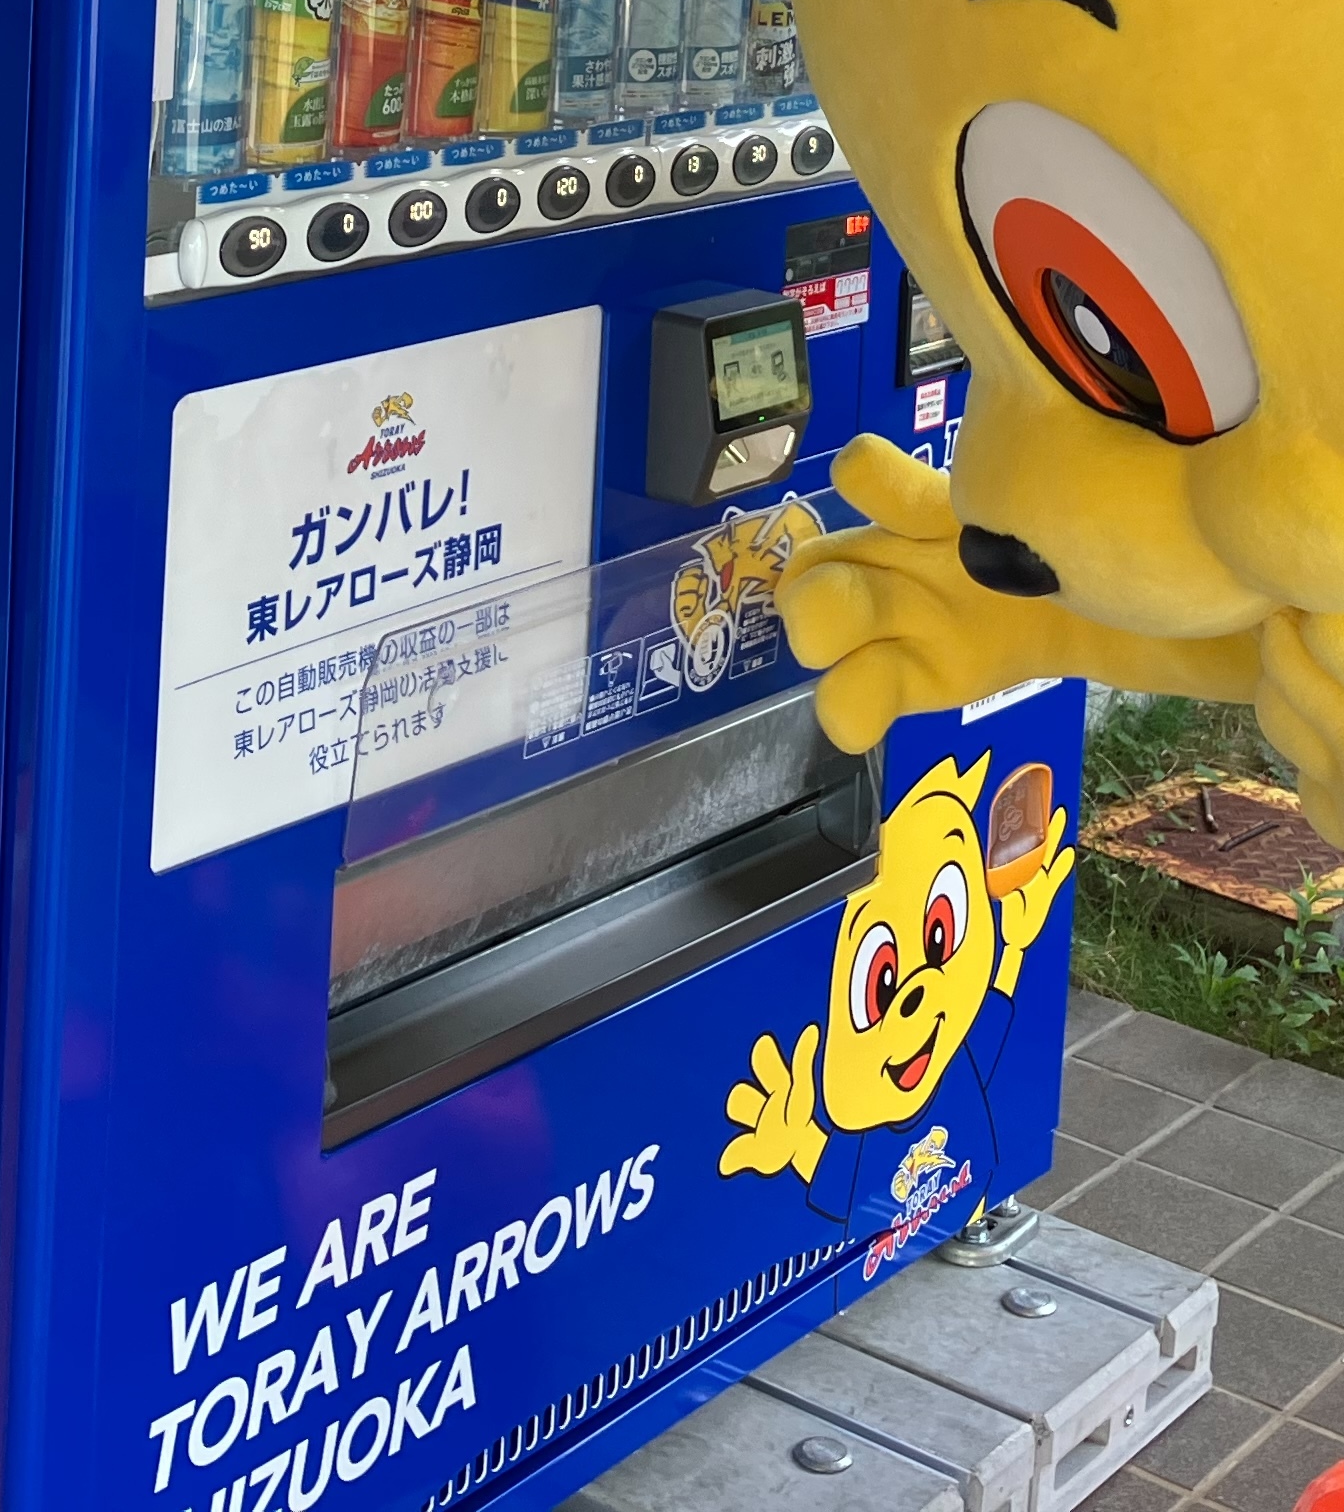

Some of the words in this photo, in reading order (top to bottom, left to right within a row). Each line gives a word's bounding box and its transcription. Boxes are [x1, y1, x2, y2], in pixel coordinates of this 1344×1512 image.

[755, 41, 796, 72] 刺激
[294, 167, 342, 184] つめた〜い
[634, 165, 644, 183] 0
[209, 179, 259, 197] つめた〜い
[497, 188, 508, 208] 0
[556, 176, 578, 197] 120
[409, 199, 434, 222] 100
[343, 213, 355, 234] 0
[379, 423, 406, 440] TORAY
[346, 429, 427, 475] Arrows
[370, 463, 407, 481] SHIZUOKA
[287, 469, 471, 570] ガンバレ!
[244, 521, 504, 645] 東レアローズ静岡
[234, 600, 512, 716] この自動販売機の収益の一部は
[307, 700, 447, 777] 役立てられます
[169, 1246, 287, 1376] WE
[296, 1167, 438, 1312] ARE
[148, 1289, 396, 1494] TORAY
[396, 1143, 660, 1357] ARROWS
